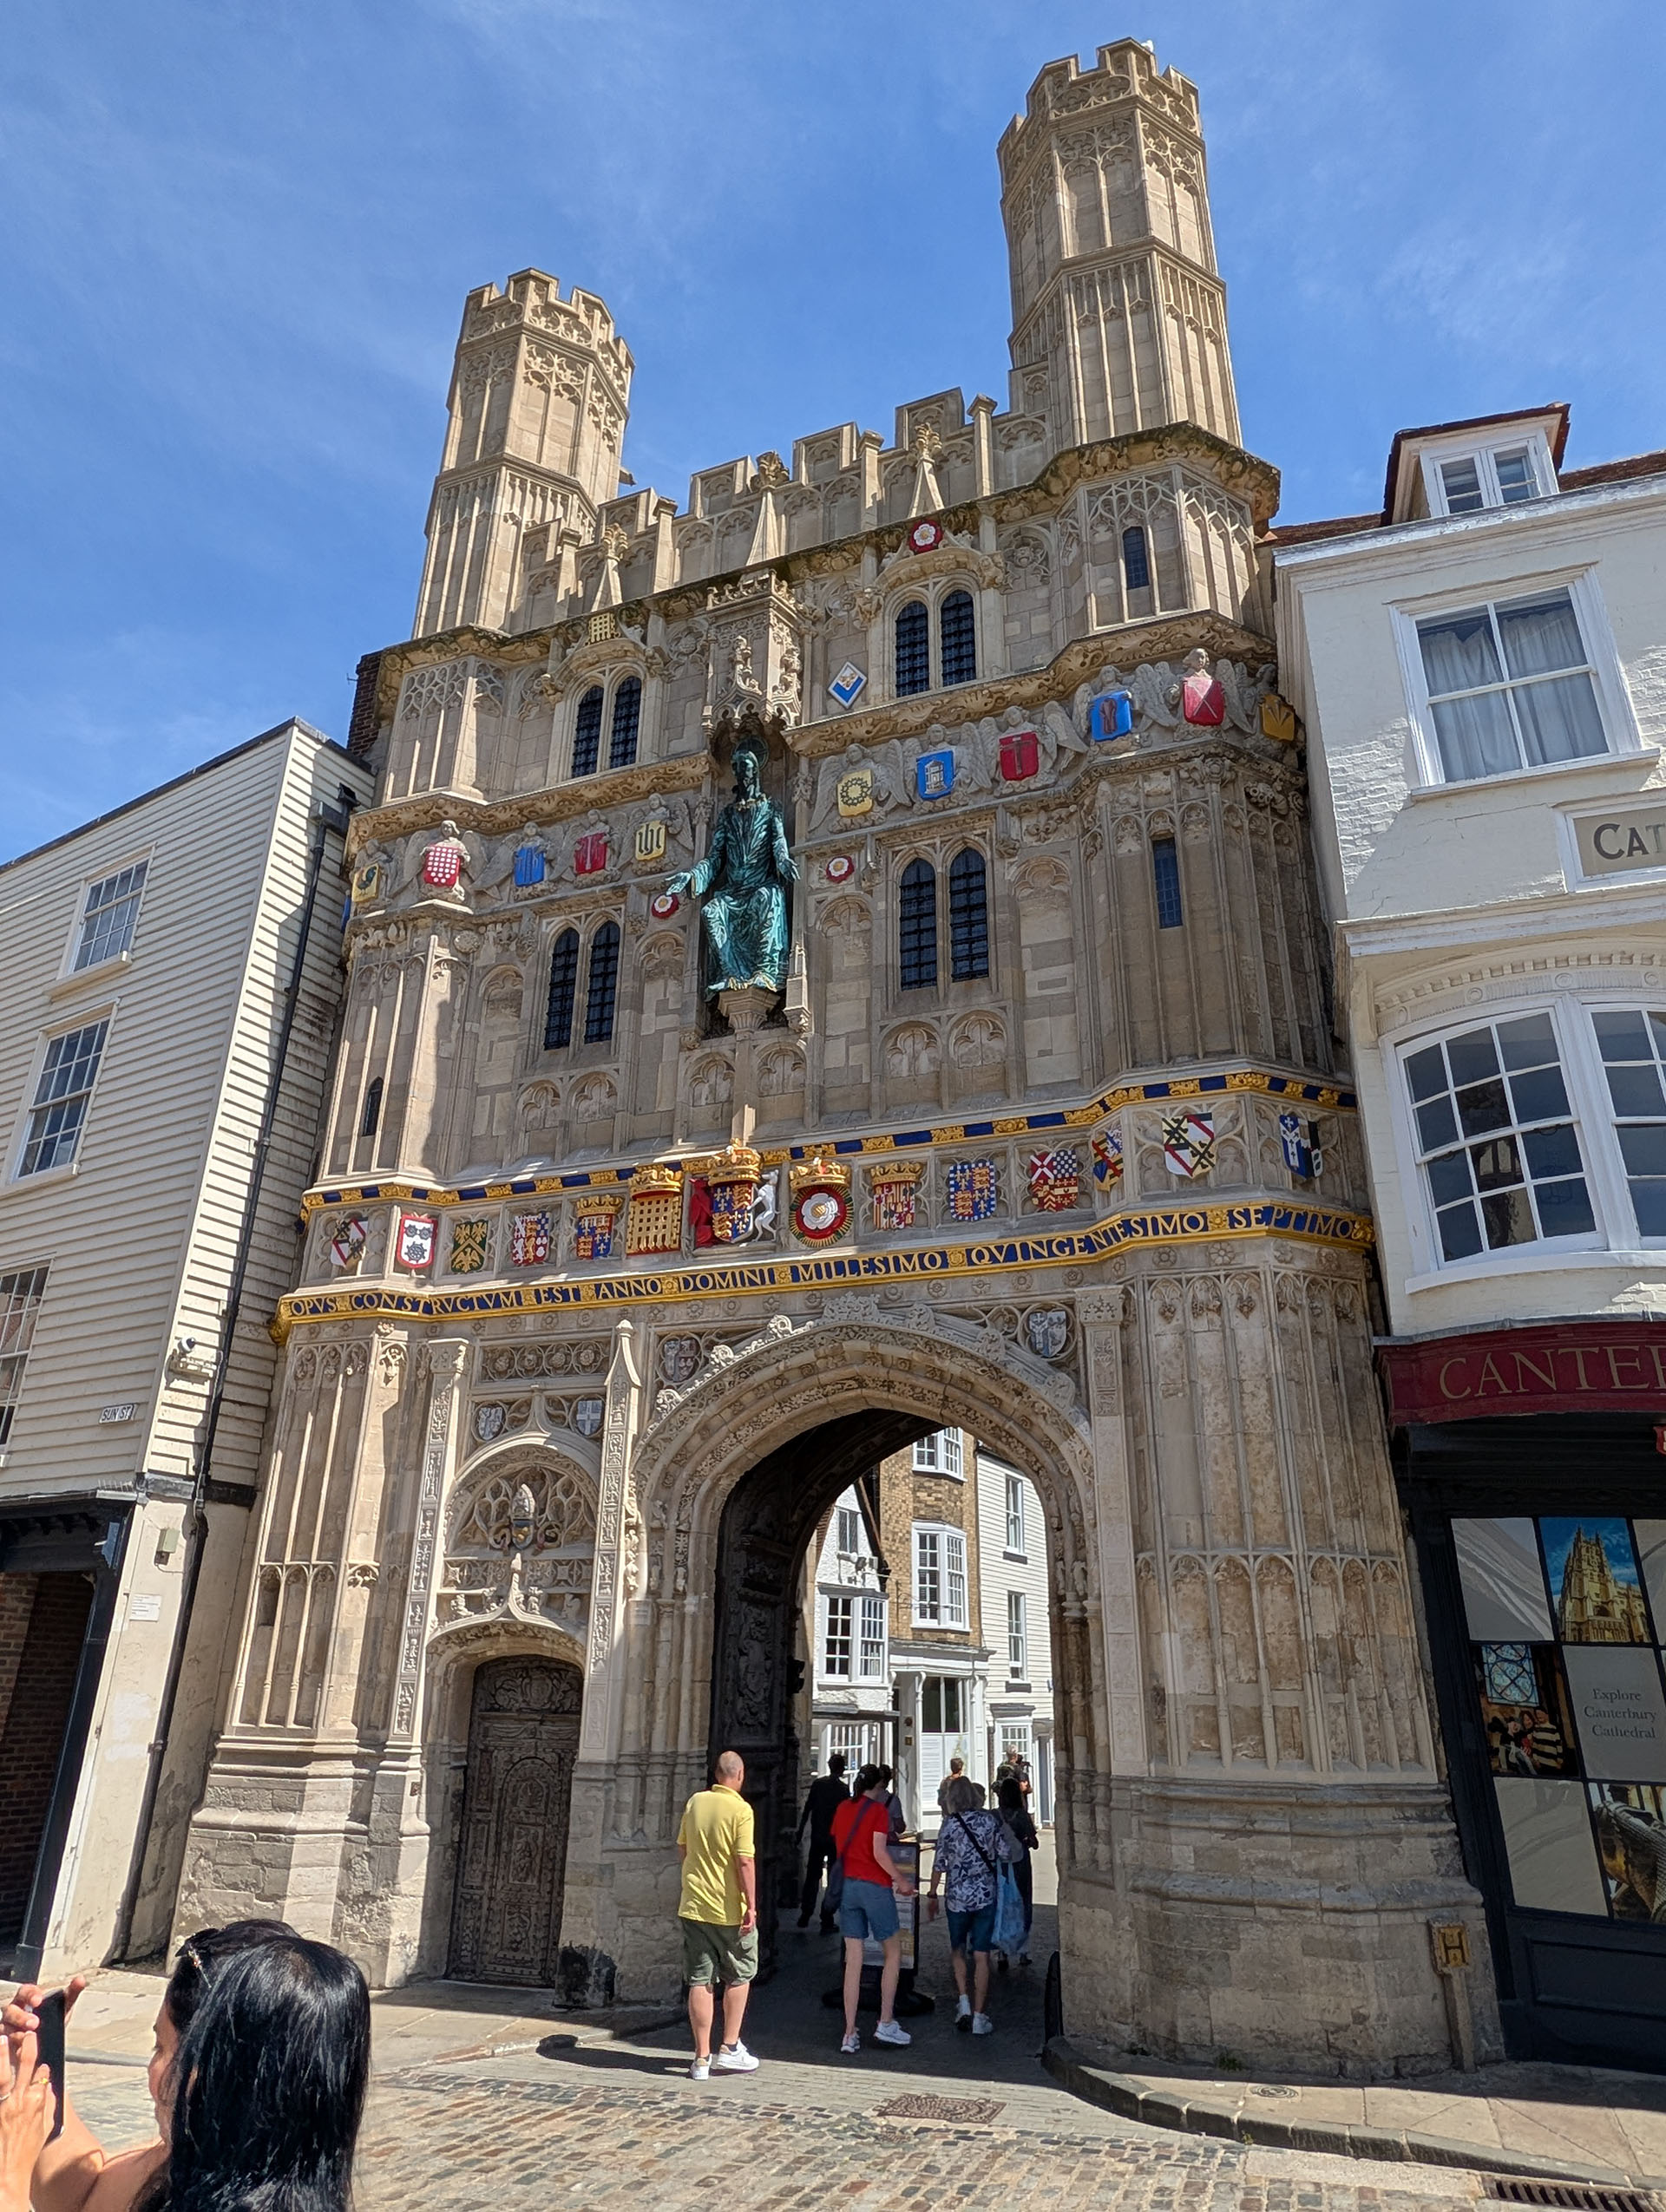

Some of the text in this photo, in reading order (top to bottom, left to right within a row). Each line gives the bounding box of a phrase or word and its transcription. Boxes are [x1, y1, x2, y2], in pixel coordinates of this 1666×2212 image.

[291, 1207, 1354, 1317] OPVS CONSTRVCTVM EST ANNO DOMINI MILLESIMO QVINGENTESIMO SEPTIMO
[102, 1407, 119, 1421] SUN
[1593, 1689, 1642, 1703] Explore
[1584, 1705, 1656, 1723] Canterbury
[1592, 1724, 1656, 1738] Cathedral
[1440, 1932, 1466, 1964] H
